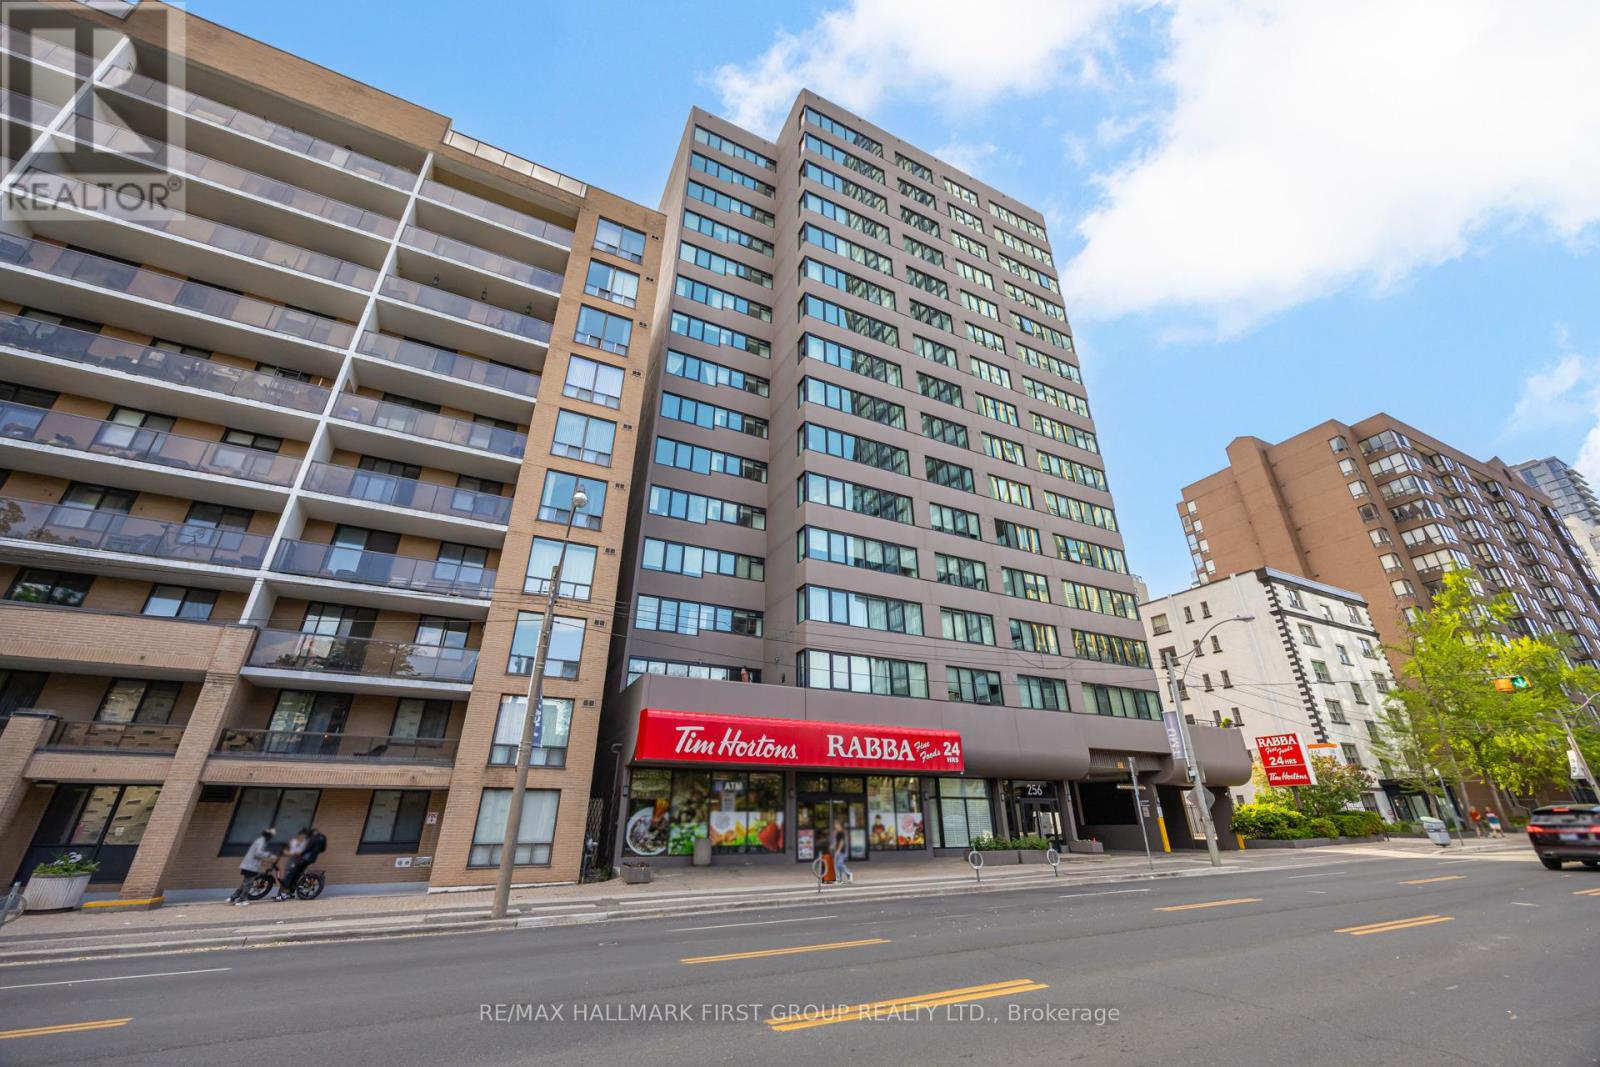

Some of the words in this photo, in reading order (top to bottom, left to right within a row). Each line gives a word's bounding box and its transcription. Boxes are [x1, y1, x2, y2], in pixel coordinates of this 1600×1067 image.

[675, 726, 716, 755] Tim
[1258, 735, 1297, 747] RABBA
[826, 734, 916, 761] RABBA
[943, 742, 961, 756] 24
[920, 748, 941, 763] Foods
[1269, 756, 1284, 766] 24
[724, 781, 743, 791] ATM
[1026, 783, 1043, 796] 256
